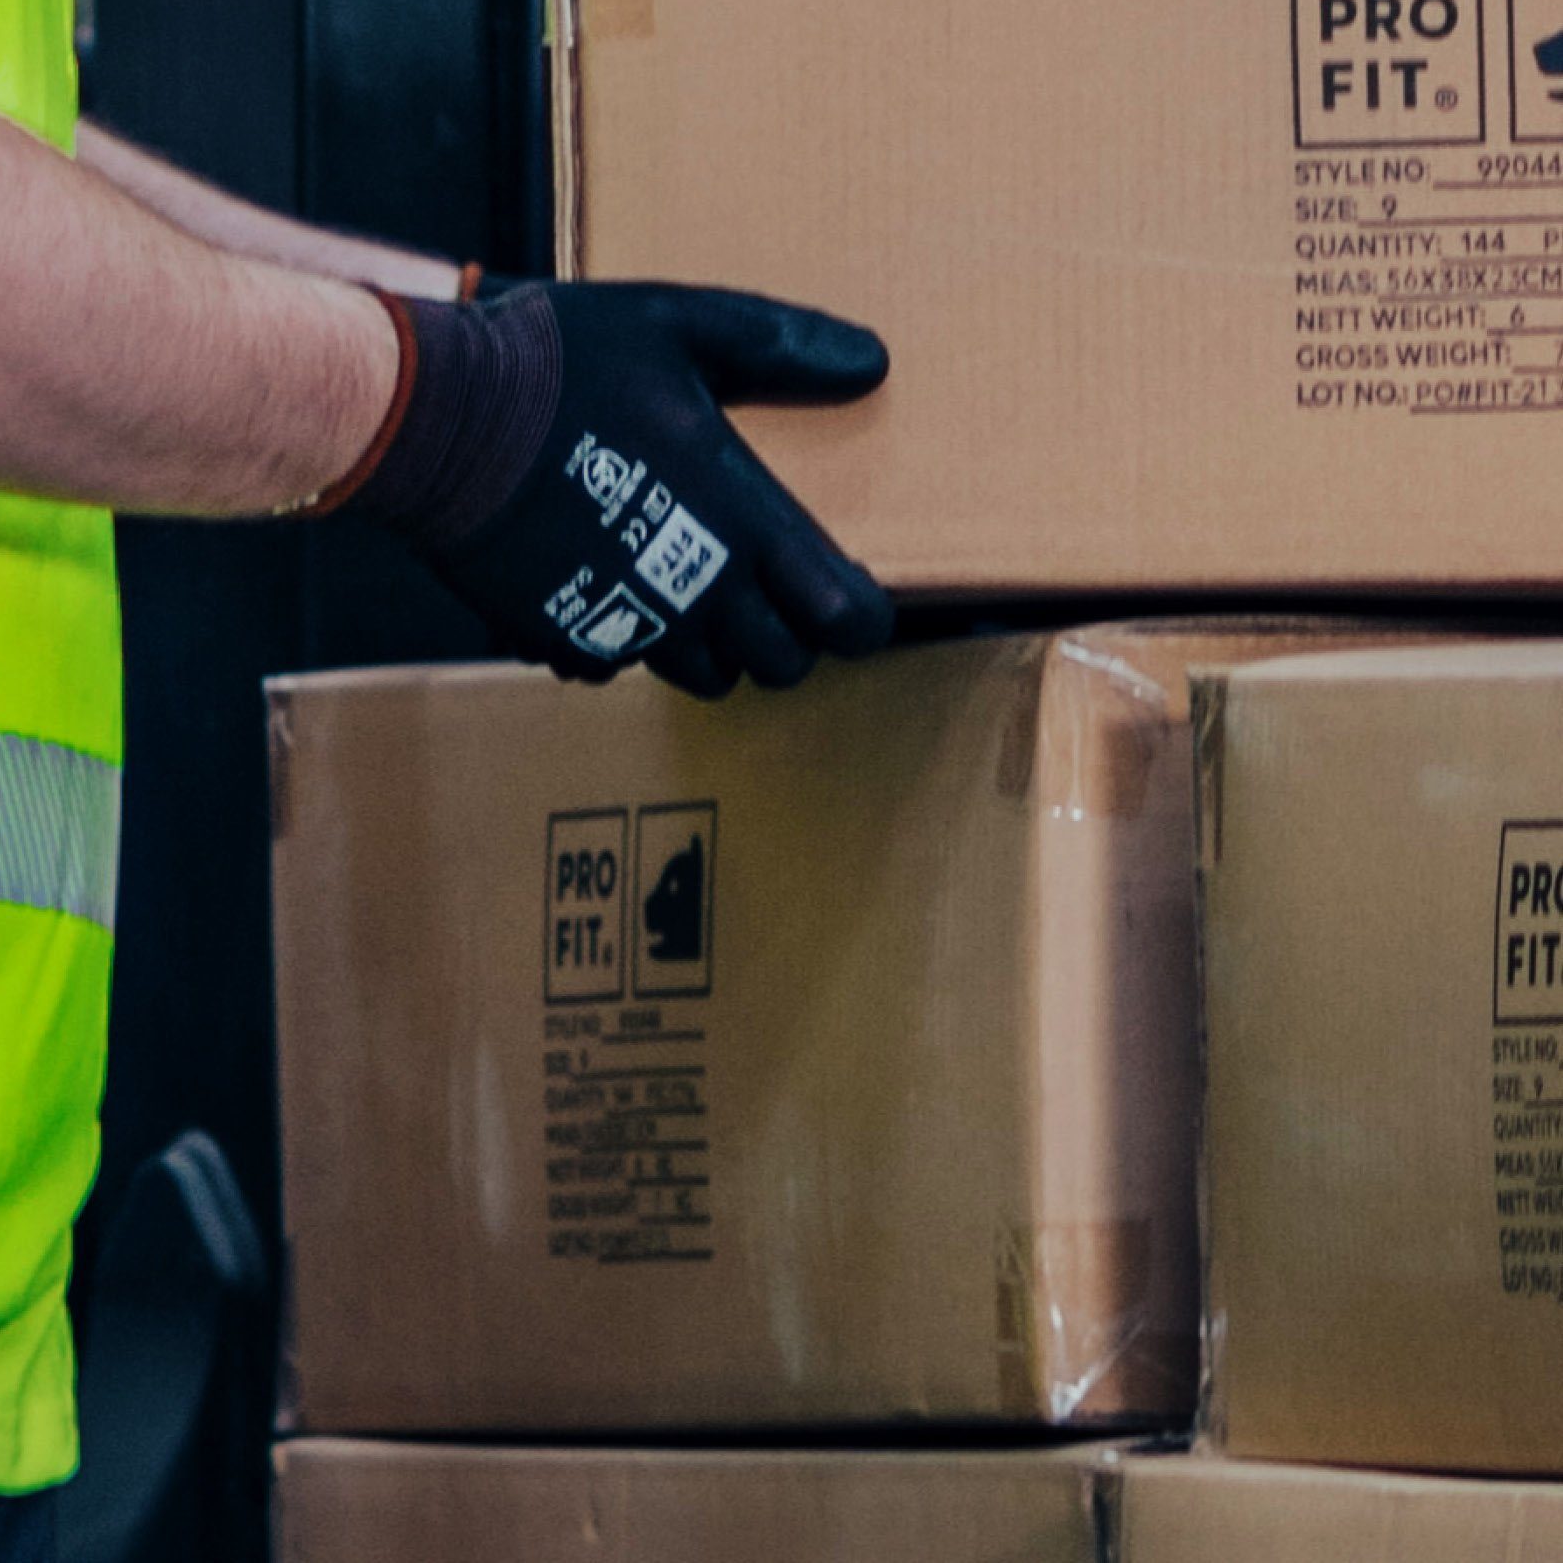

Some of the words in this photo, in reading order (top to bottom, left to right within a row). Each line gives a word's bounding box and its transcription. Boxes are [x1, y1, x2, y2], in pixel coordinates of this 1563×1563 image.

[1295, 158, 1374, 185] STYLE
[1381, 194, 1397, 220] 9
[1461, 229, 1505, 253] 144
[1295, 306, 1361, 333] NETT
[1295, 343, 1388, 371] GROSS
[1296, 380, 1348, 408] LOT
[557, 849, 617, 902] PRO
